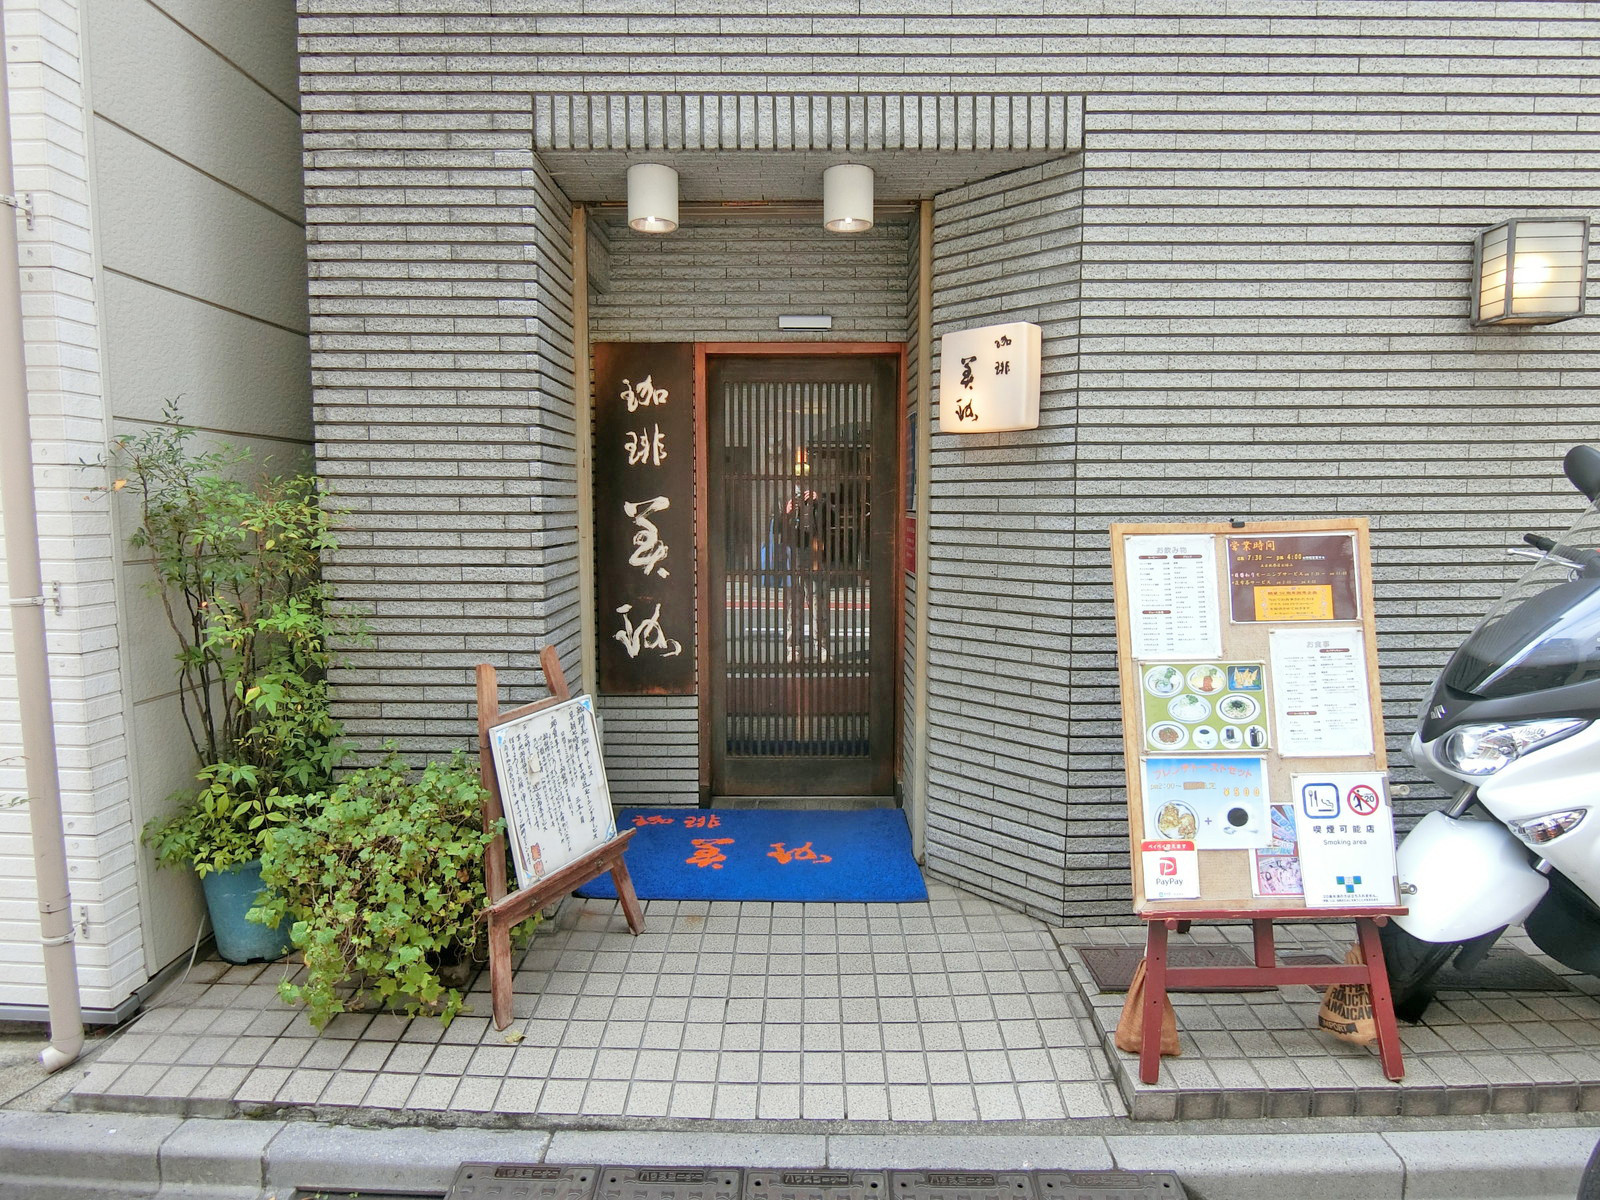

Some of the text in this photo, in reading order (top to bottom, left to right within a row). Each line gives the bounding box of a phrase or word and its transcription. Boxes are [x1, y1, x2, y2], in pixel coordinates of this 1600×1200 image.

[994, 335, 1012, 376] 珈琲
[1156, 546, 1188, 554] お飲み物
[1230, 540, 1276, 551] 営業時間
[1306, 640, 1330, 648] お食事
[1152, 762, 1252, 780] フレンチトーストセット
[1224, 787, 1260, 798] ¥500
[1313, 824, 1375, 834] 喫煙可能店
[1156, 878, 1184, 886] PayPay
